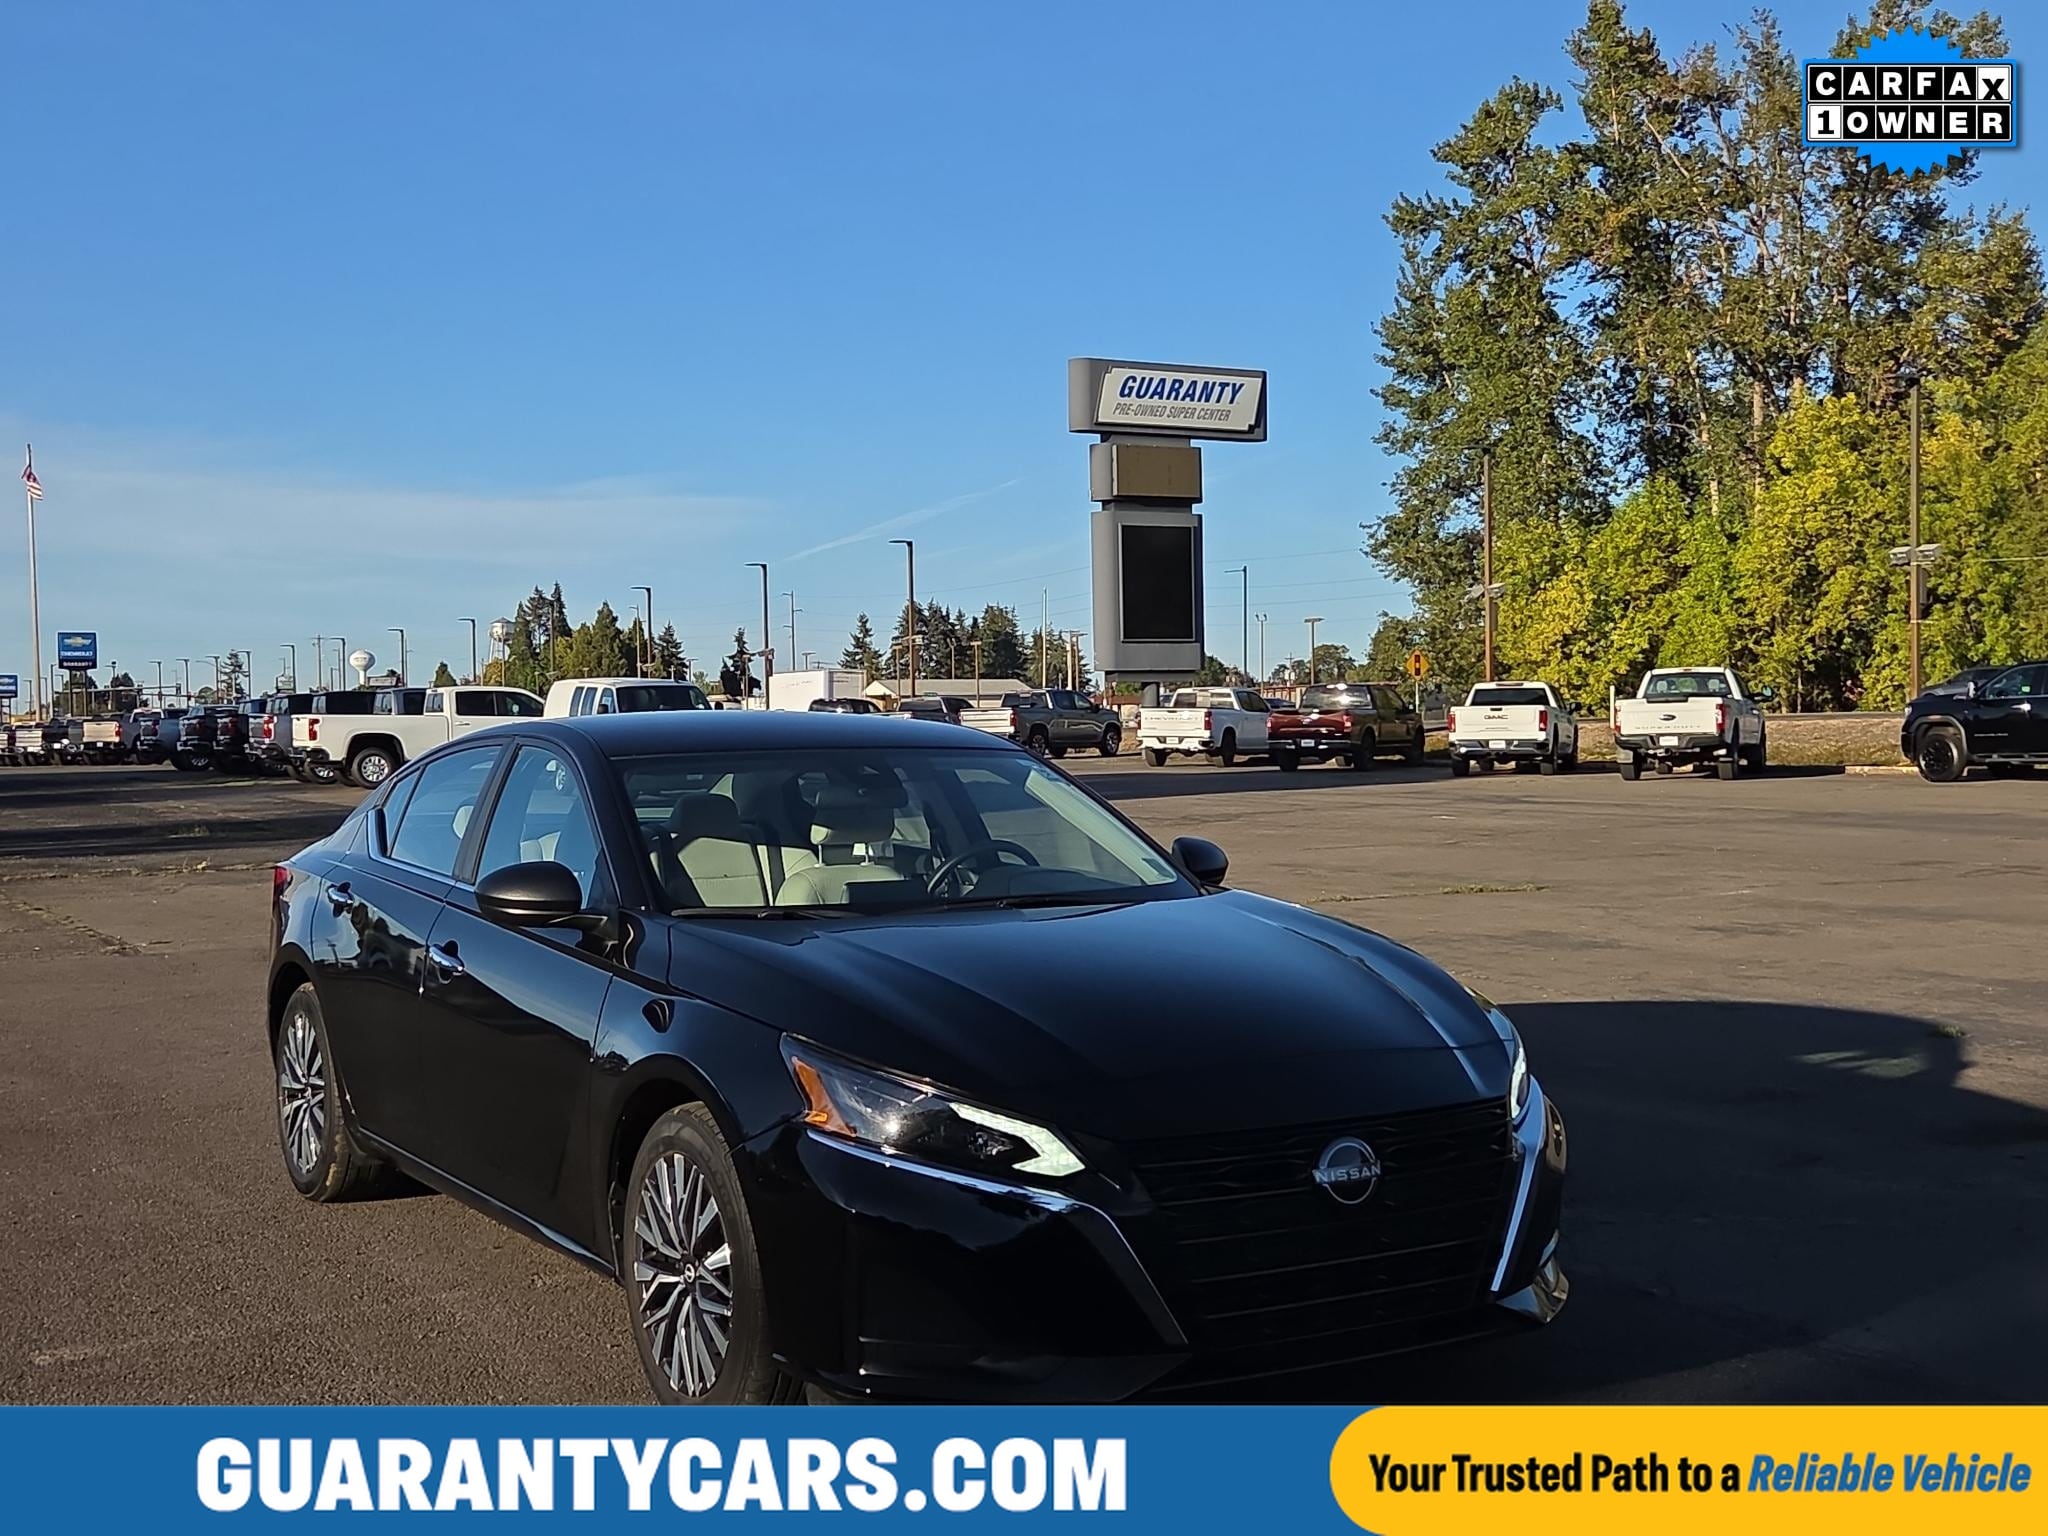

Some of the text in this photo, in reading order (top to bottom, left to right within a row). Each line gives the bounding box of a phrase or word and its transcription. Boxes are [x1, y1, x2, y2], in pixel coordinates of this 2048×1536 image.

[1119, 375, 1246, 405] GUARANTY
[1112, 402, 1231, 422] PRE-OWNED SUPER CENTER
[1312, 1160, 1381, 1184] NISSAN
